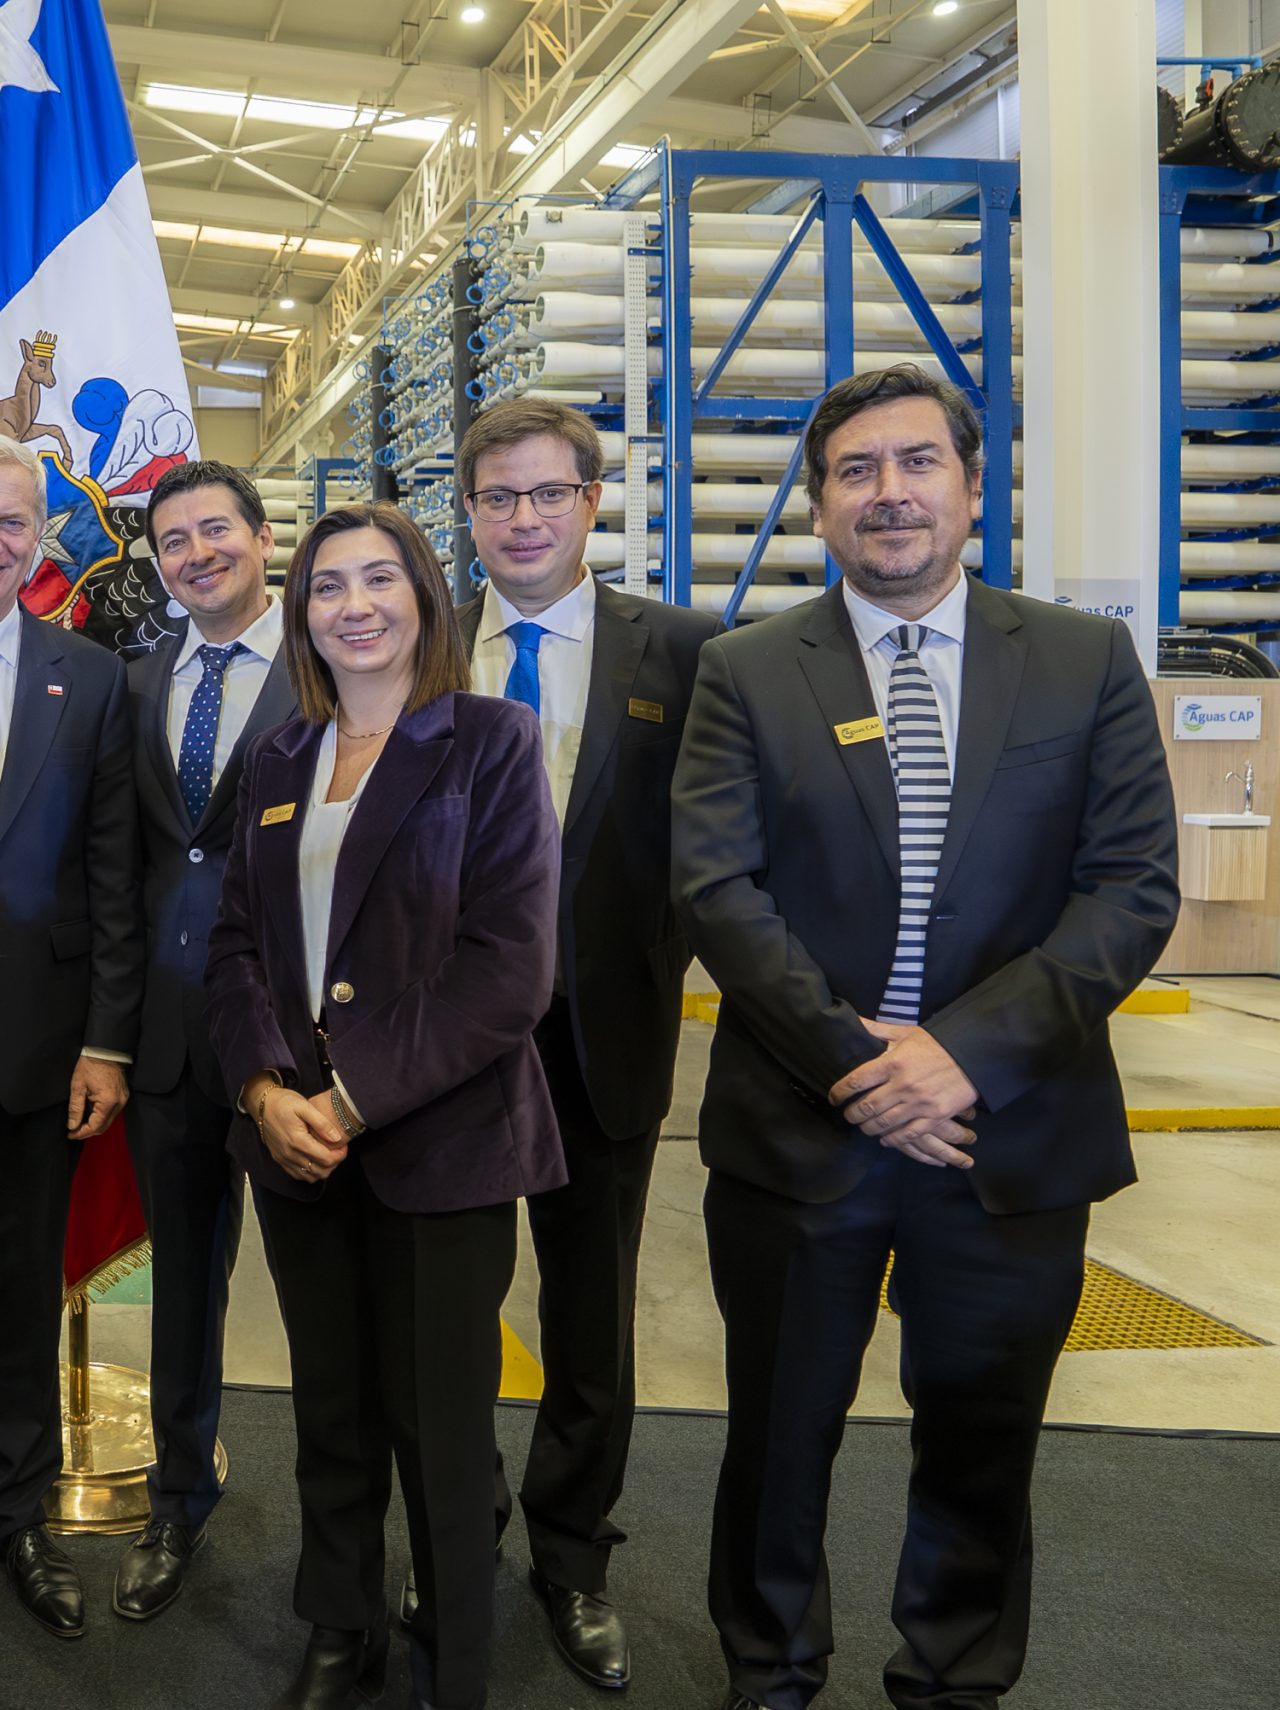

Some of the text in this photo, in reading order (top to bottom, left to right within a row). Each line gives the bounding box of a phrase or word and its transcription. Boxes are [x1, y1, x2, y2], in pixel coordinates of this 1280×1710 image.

[1105, 605, 1134, 618] CAP
[1189, 710, 1254, 725] Aguas CAP
